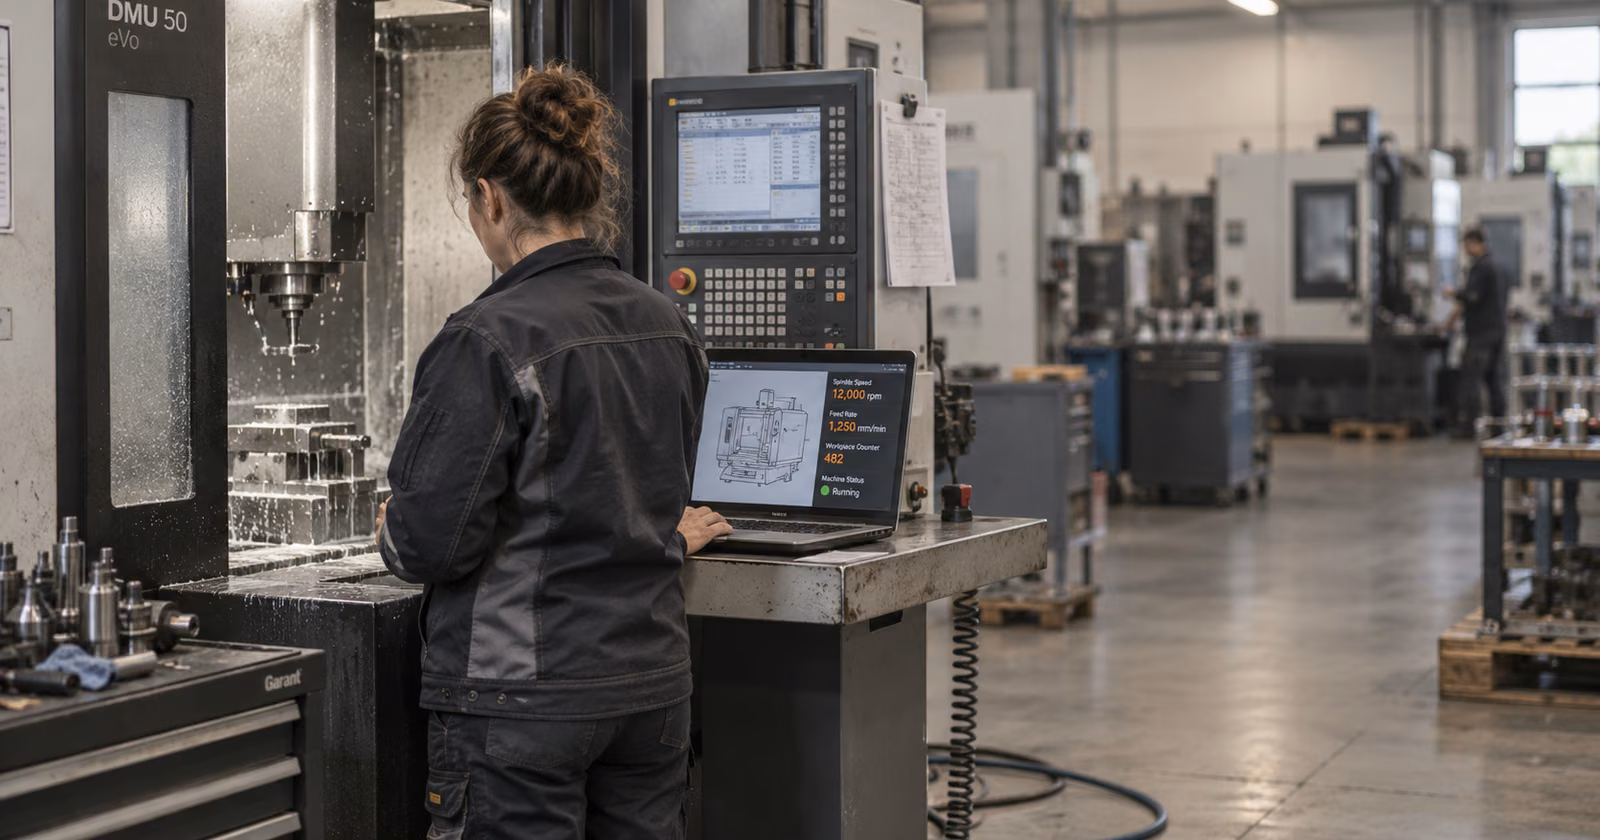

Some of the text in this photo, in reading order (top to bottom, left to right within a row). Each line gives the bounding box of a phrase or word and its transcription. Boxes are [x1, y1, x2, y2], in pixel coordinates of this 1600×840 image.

[108, 0, 187, 32] DMU 50
[108, 28, 139, 49] eVo
[833, 388, 882, 401] 12,000 rpm
[829, 421, 856, 432] 1,250
[856, 443, 880, 451] Counter
[824, 453, 844, 464] 482
[821, 475, 865, 484] Machine Status
[832, 487, 860, 499] Running
[265, 668, 302, 691] Garant
